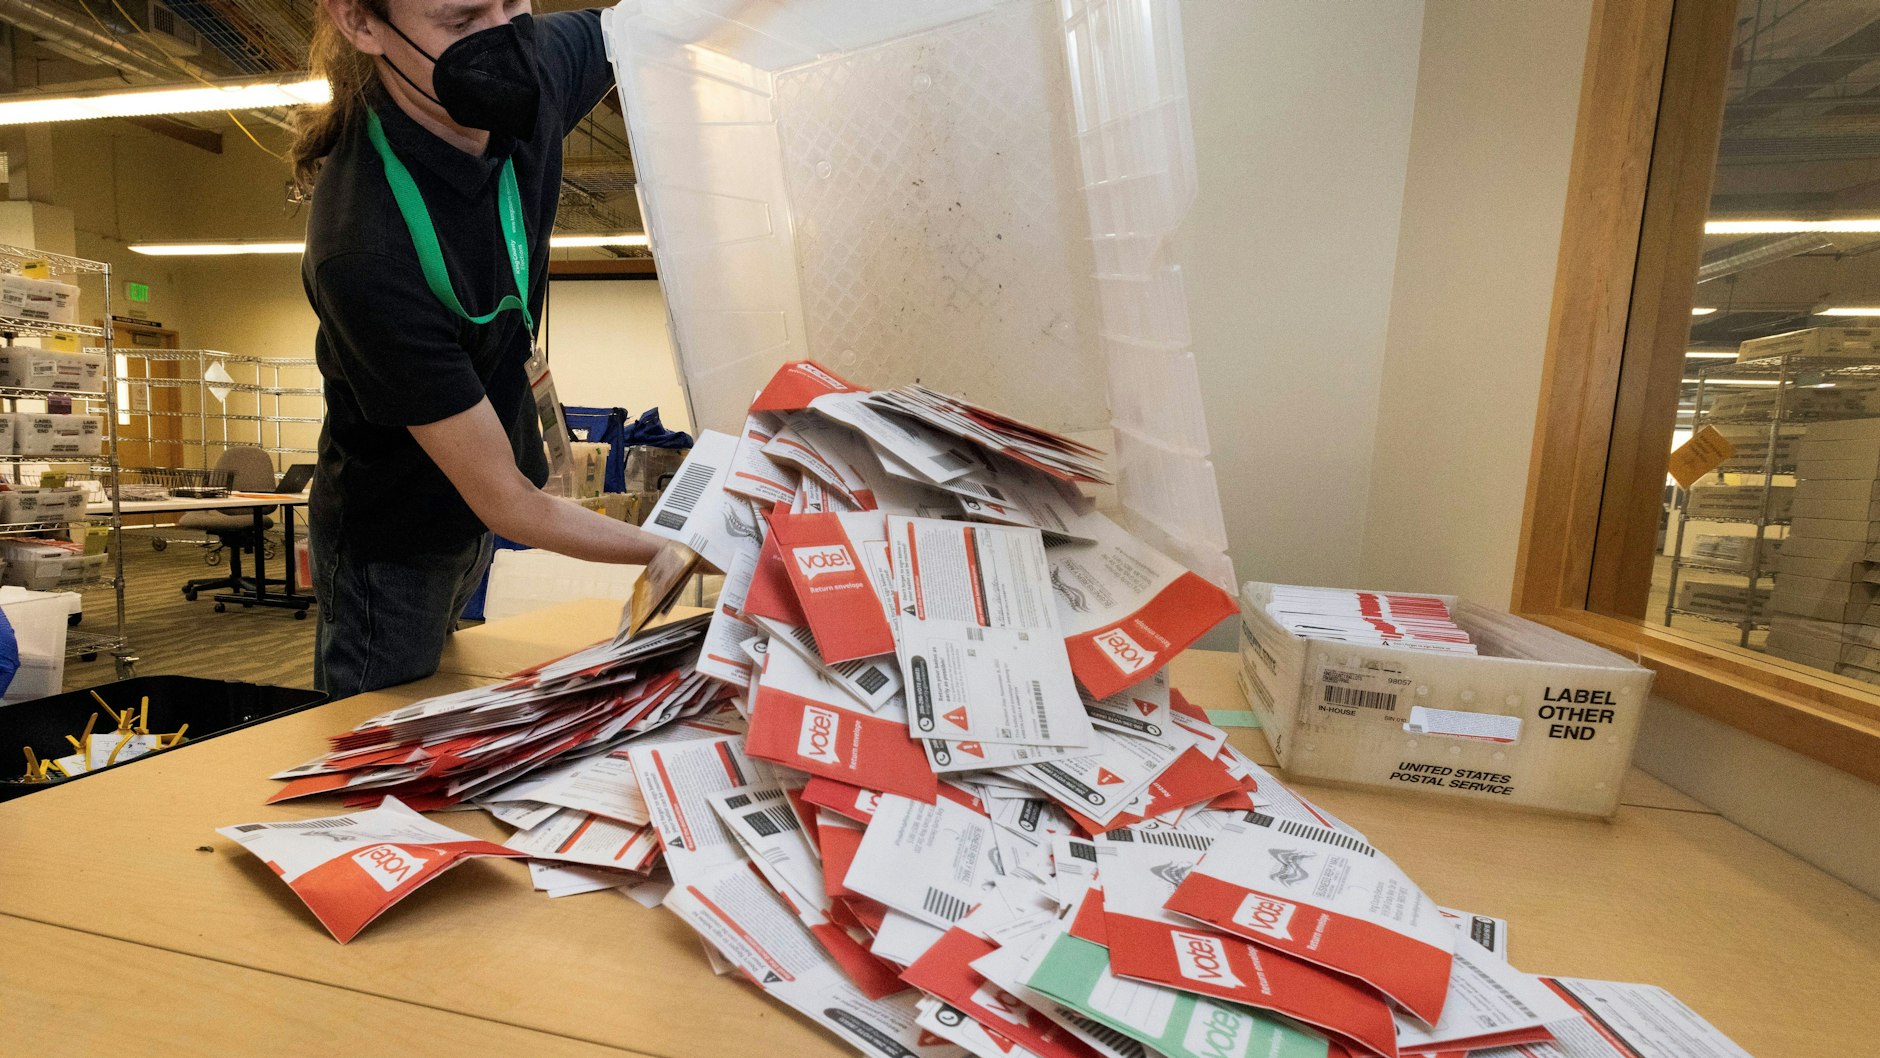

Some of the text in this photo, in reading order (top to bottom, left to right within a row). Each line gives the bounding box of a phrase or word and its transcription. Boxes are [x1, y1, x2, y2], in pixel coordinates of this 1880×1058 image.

[798, 548, 854, 571] vote!
[809, 581, 864, 594] Return envelope
[1098, 632, 1144, 668] vote!
[939, 657, 948, 681] possible!
[936, 682, 944, 702] Return
[1387, 678, 1412, 686] 98057
[944, 688, 952, 702] early
[1543, 686, 1617, 706] LABEL
[1318, 705, 1357, 717] IN-HOUSE
[1538, 705, 1615, 724] OTHER
[804, 709, 832, 757] vote!
[1548, 724, 1596, 741] END
[849, 720, 863, 770] Return envelope
[1389, 771, 1515, 796] POSTAL SERVICE
[1398, 761, 1511, 784] UNITED STATES
[969, 826, 983, 853] BUSINESS
[359, 846, 411, 882] vote!
[1315, 876, 1331, 897] BUSINESS
[1249, 896, 1287, 930] vote!
[1306, 913, 1330, 951] Return envelope
[1178, 934, 1222, 979] vote!
[1247, 944, 1273, 996] Return envelope
[1200, 1009, 1241, 1058] vote
